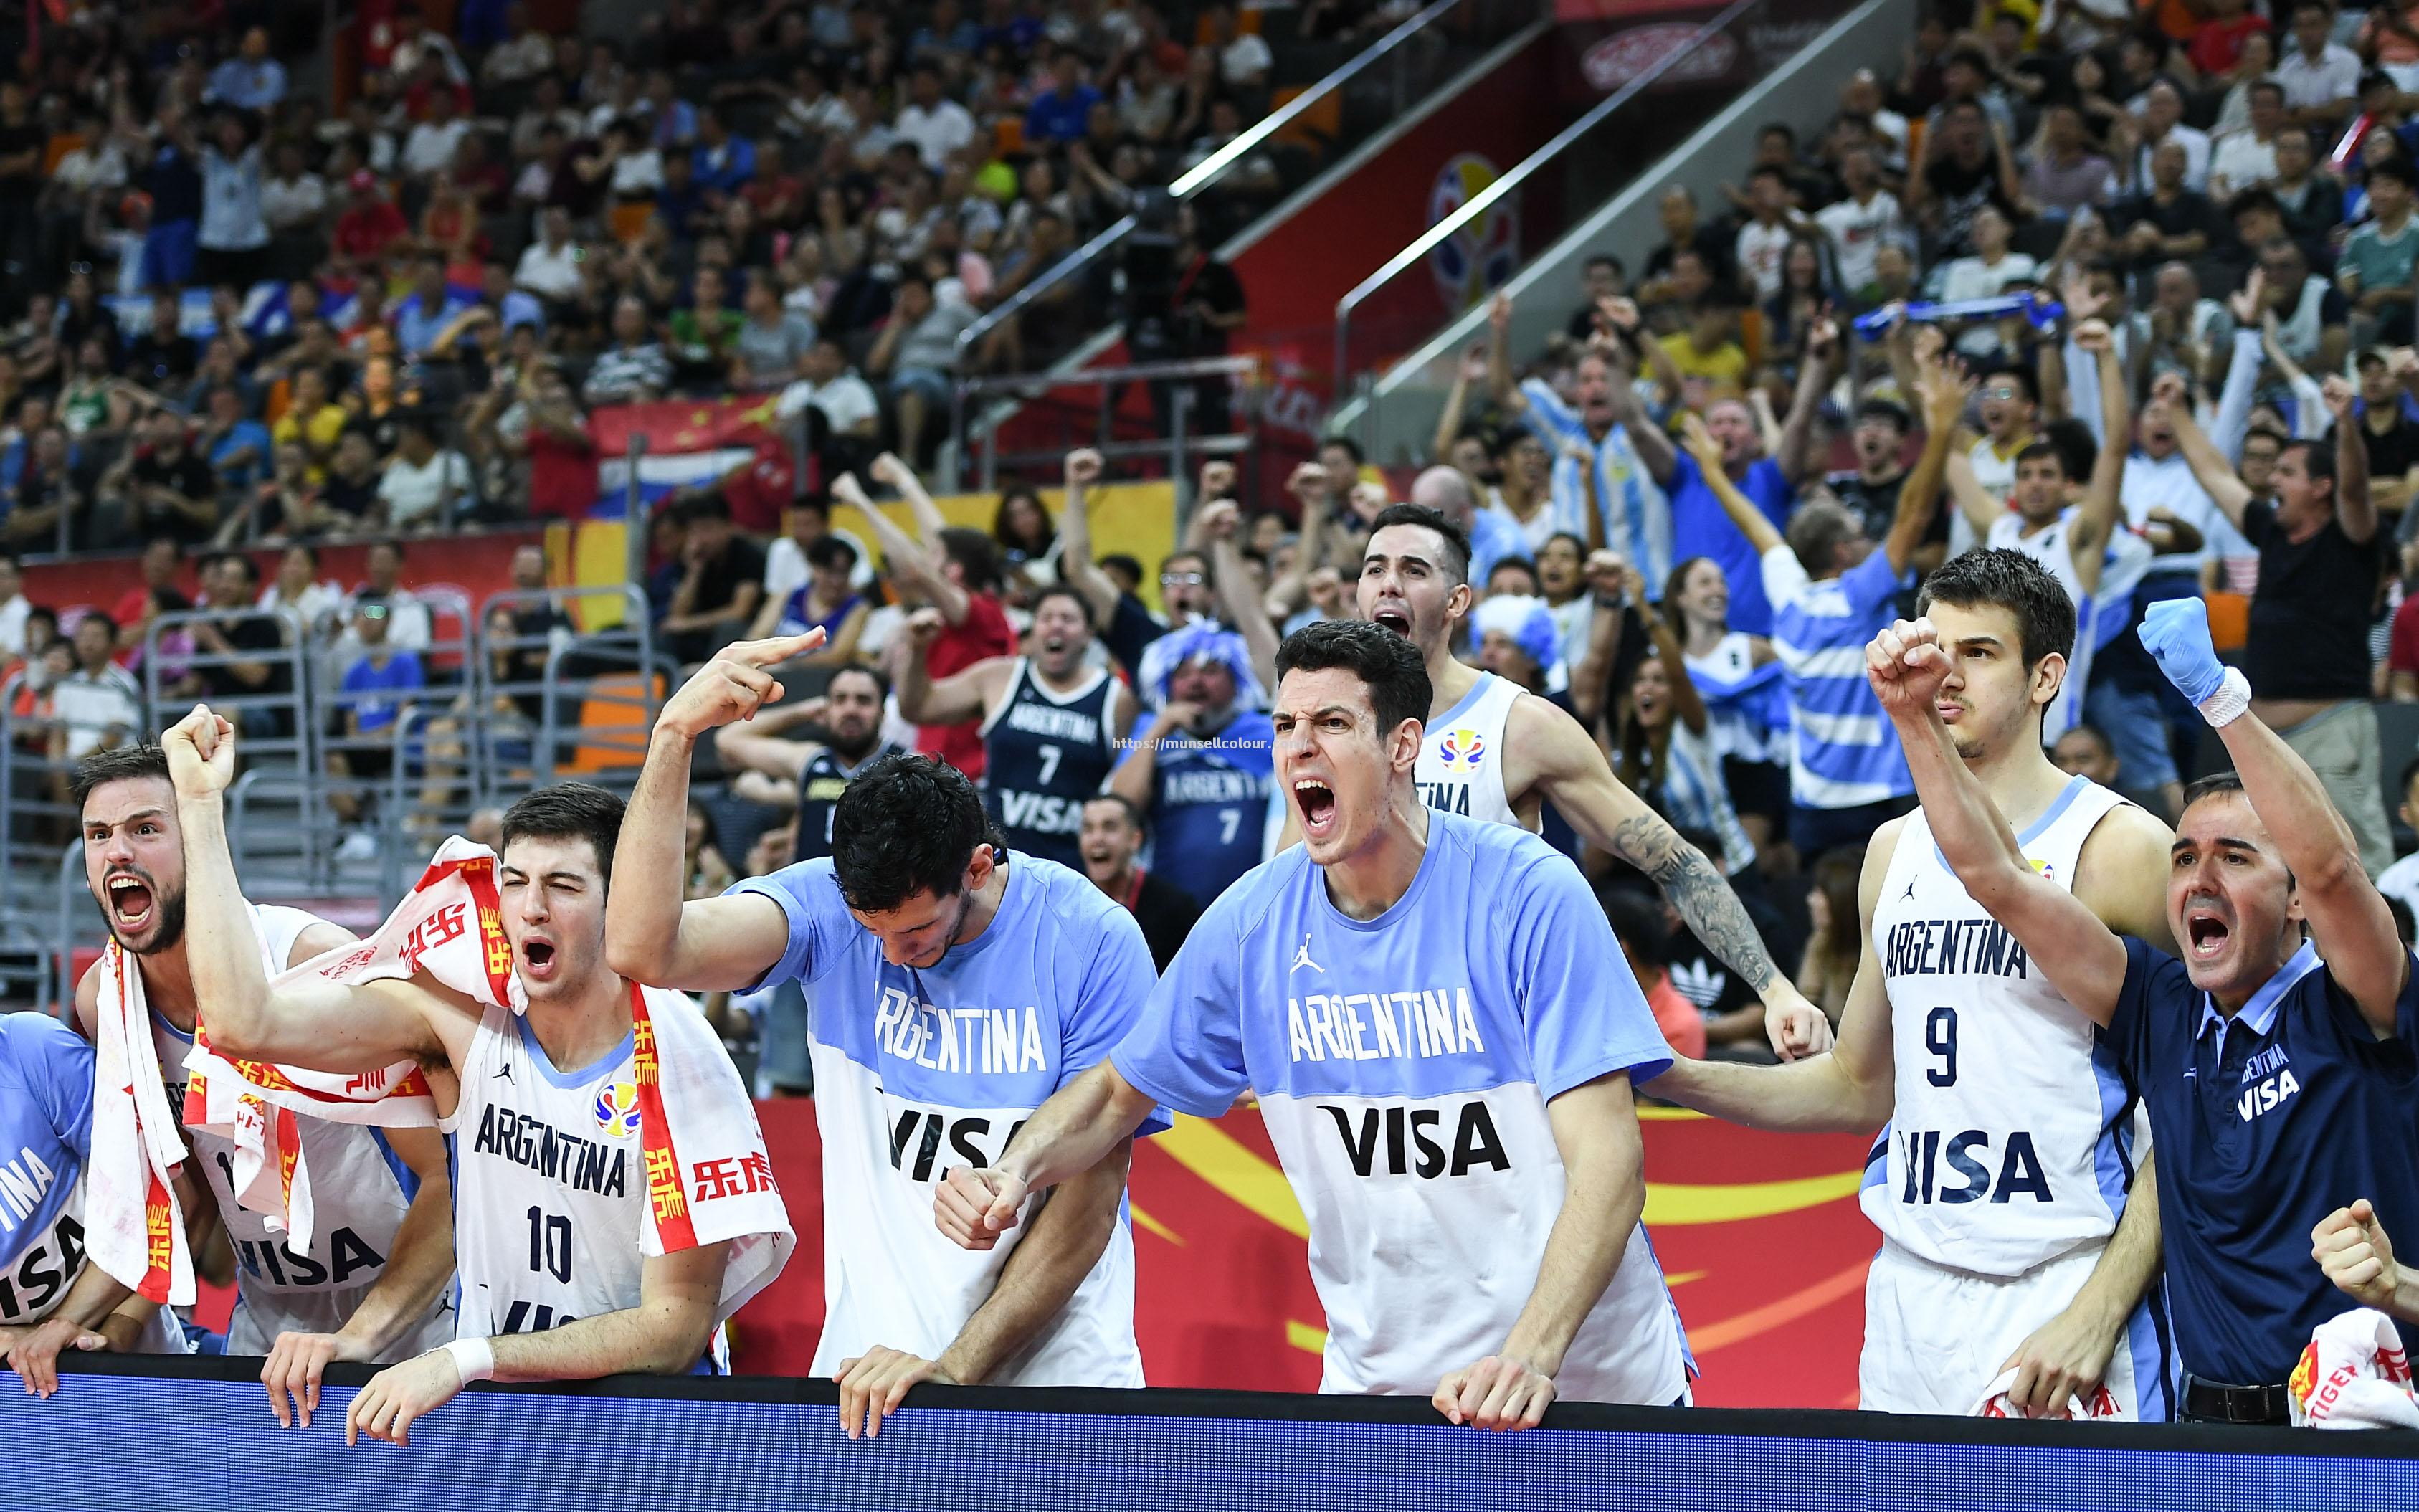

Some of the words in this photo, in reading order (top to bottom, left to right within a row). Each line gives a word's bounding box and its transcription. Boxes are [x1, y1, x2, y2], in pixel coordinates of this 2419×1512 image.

[1037, 743, 1062, 786] 7
[999, 788, 1083, 841] VISA
[1219, 808, 1242, 845] 7
[875, 980, 1047, 1074] RGENTINA
[1288, 987, 1485, 1062] ARGENTINA
[1926, 1007, 1958, 1087] 9
[2238, 1069, 2300, 1123] VISA
[875, 1087, 1028, 1182] VIS
[1316, 1100, 1511, 1179] VISA
[1898, 1130, 2054, 1204] VISA
[645, 1147, 685, 1225] 乐虎
[693, 1151, 779, 1203] 乐虎
[147, 1201, 171, 1272] 乐虎
[527, 1205, 571, 1284] 10
